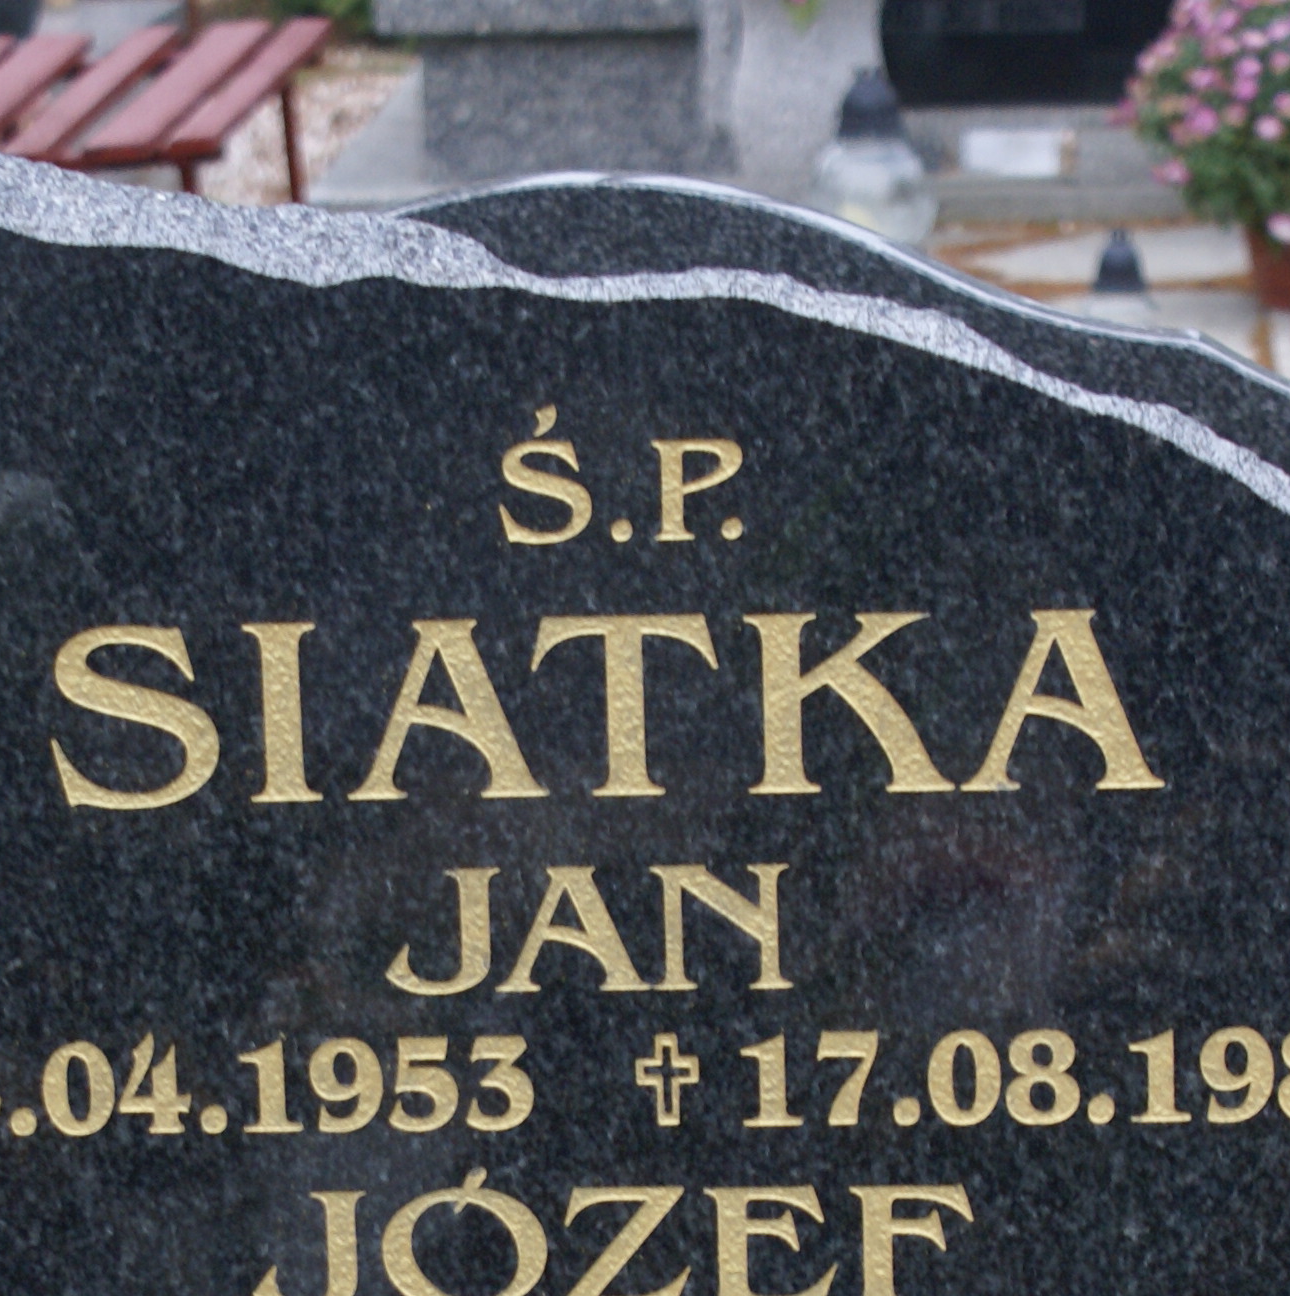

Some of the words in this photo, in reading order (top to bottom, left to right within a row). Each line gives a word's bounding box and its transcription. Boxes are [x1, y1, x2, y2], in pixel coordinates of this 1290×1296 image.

[499, 404, 744, 546] Ś.P.
[49, 608, 1166, 811] SIATKA
[386, 862, 793, 996] JAN
